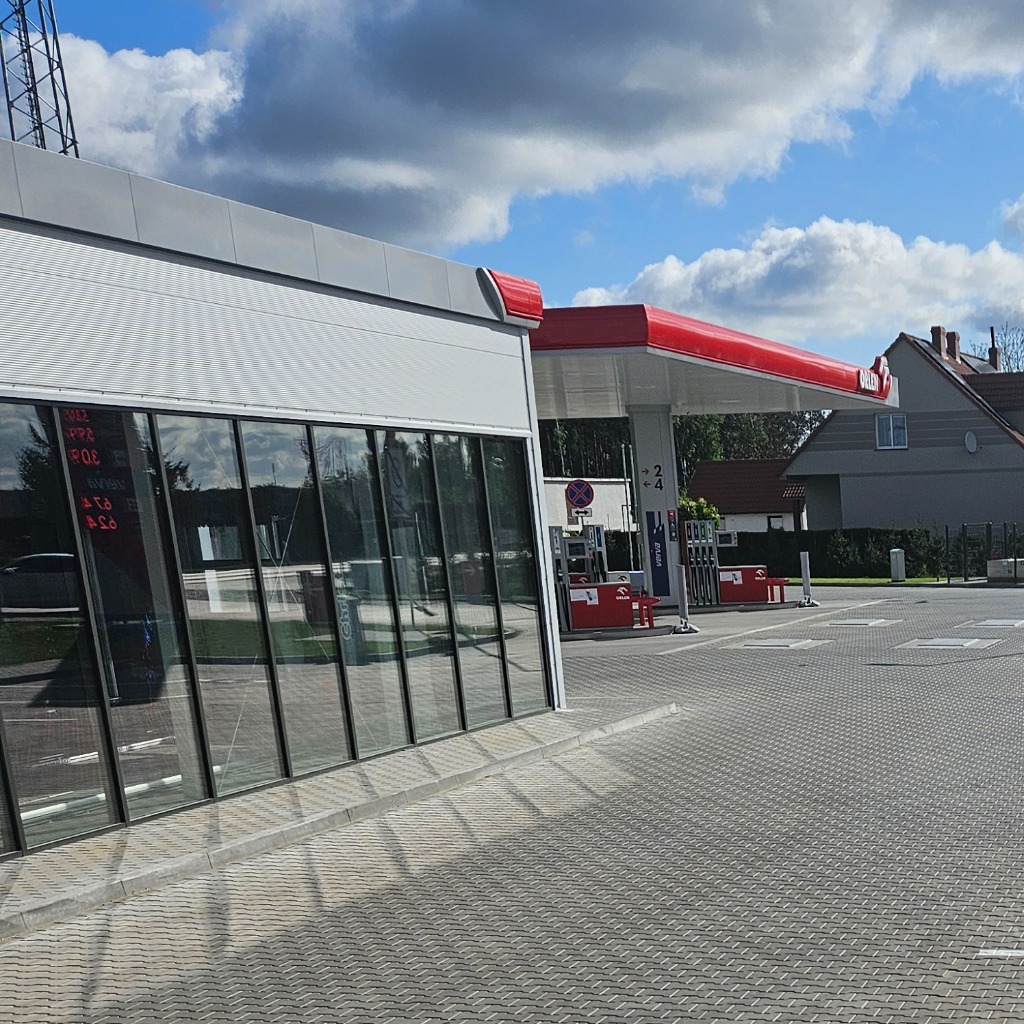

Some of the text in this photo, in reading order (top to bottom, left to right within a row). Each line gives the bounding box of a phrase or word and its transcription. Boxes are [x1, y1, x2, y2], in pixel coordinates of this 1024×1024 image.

[859, 369, 879, 392] ORLEN
[653, 464, 663, 477] 2
[654, 478, 664, 491] 4
[654, 541, 662, 568] verva
